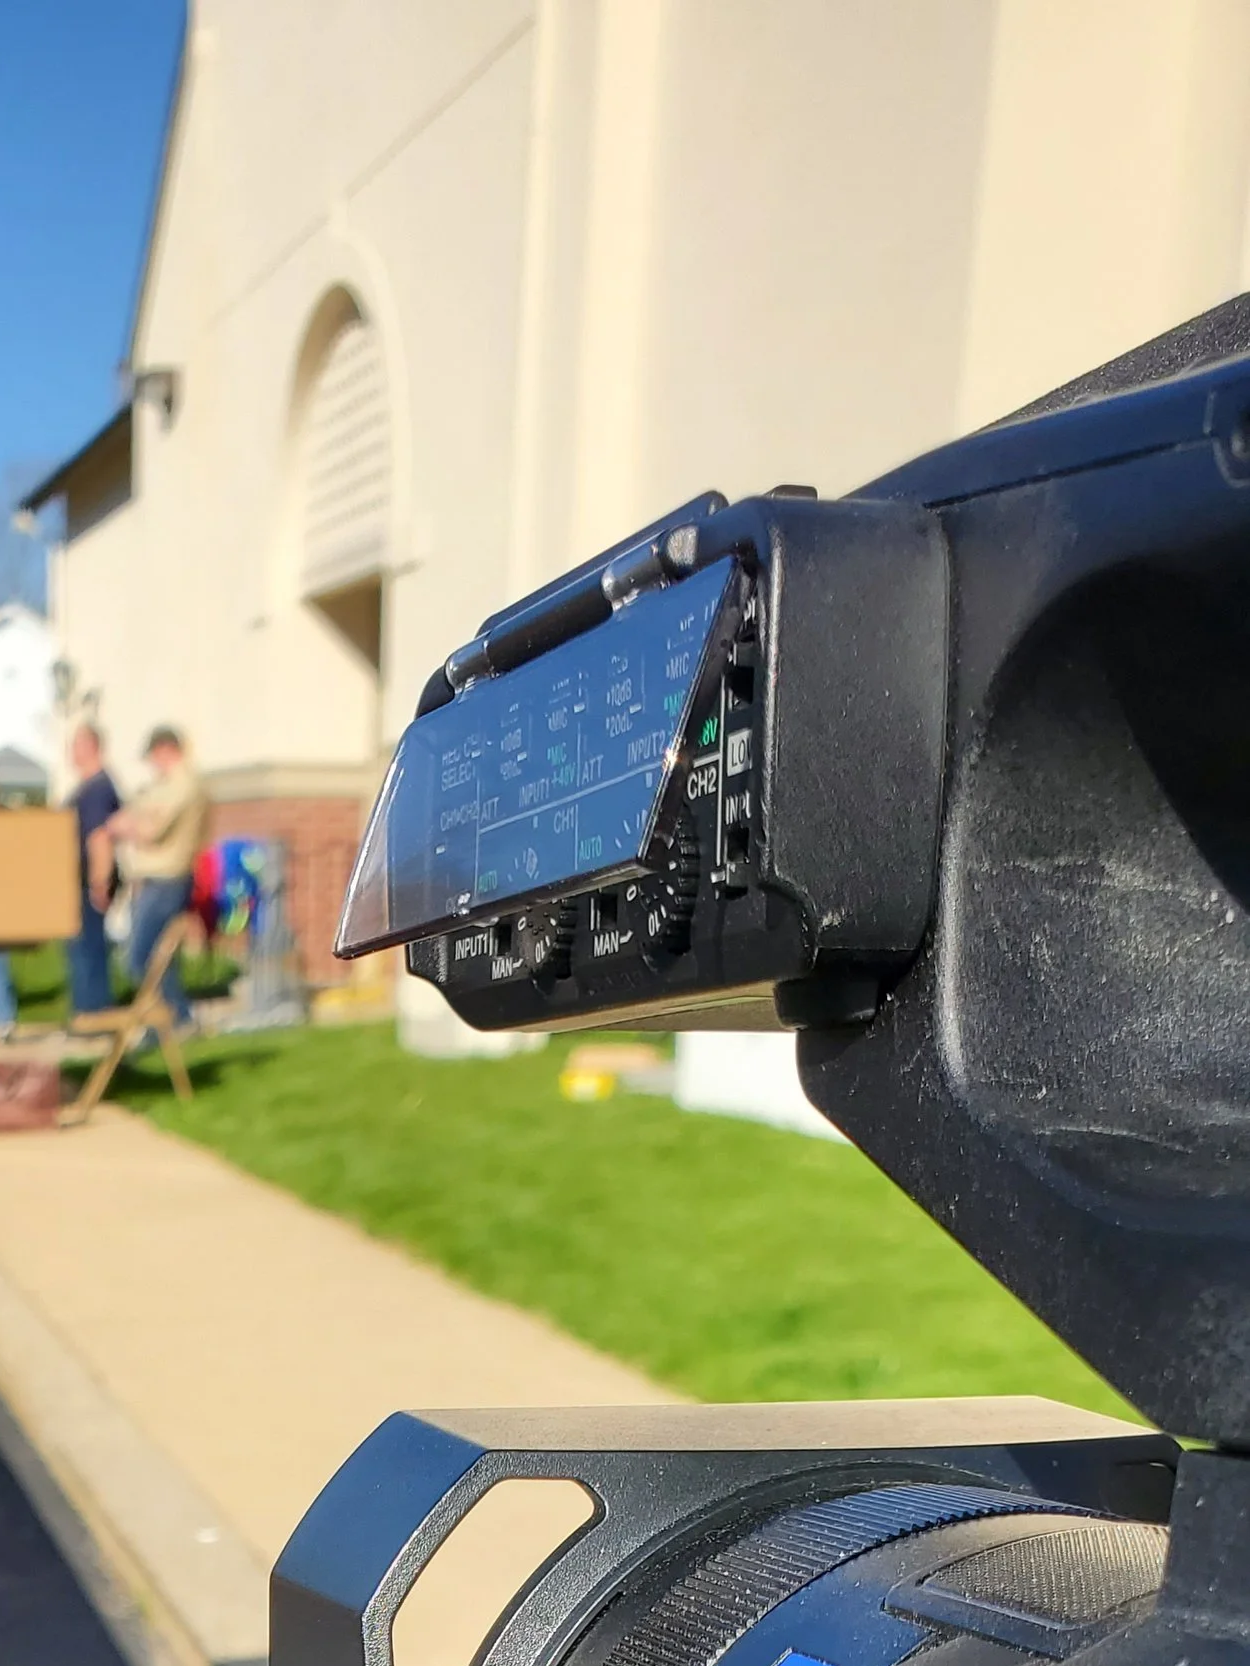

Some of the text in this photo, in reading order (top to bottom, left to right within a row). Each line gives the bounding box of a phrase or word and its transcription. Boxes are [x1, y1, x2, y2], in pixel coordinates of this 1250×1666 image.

[701, 716, 718, 746] 8V
[627, 732, 666, 766] INPUT2
[730, 739, 750, 767] LO
[581, 755, 604, 786] ATT
[687, 766, 717, 800] CH2
[480, 797, 500, 823] ATT
[553, 807, 575, 834] CH1
[579, 835, 602, 861] AUTO
[454, 933, 488, 961] INPUT1
[593, 931, 620, 958] MAN
[491, 957, 513, 980] MAN
